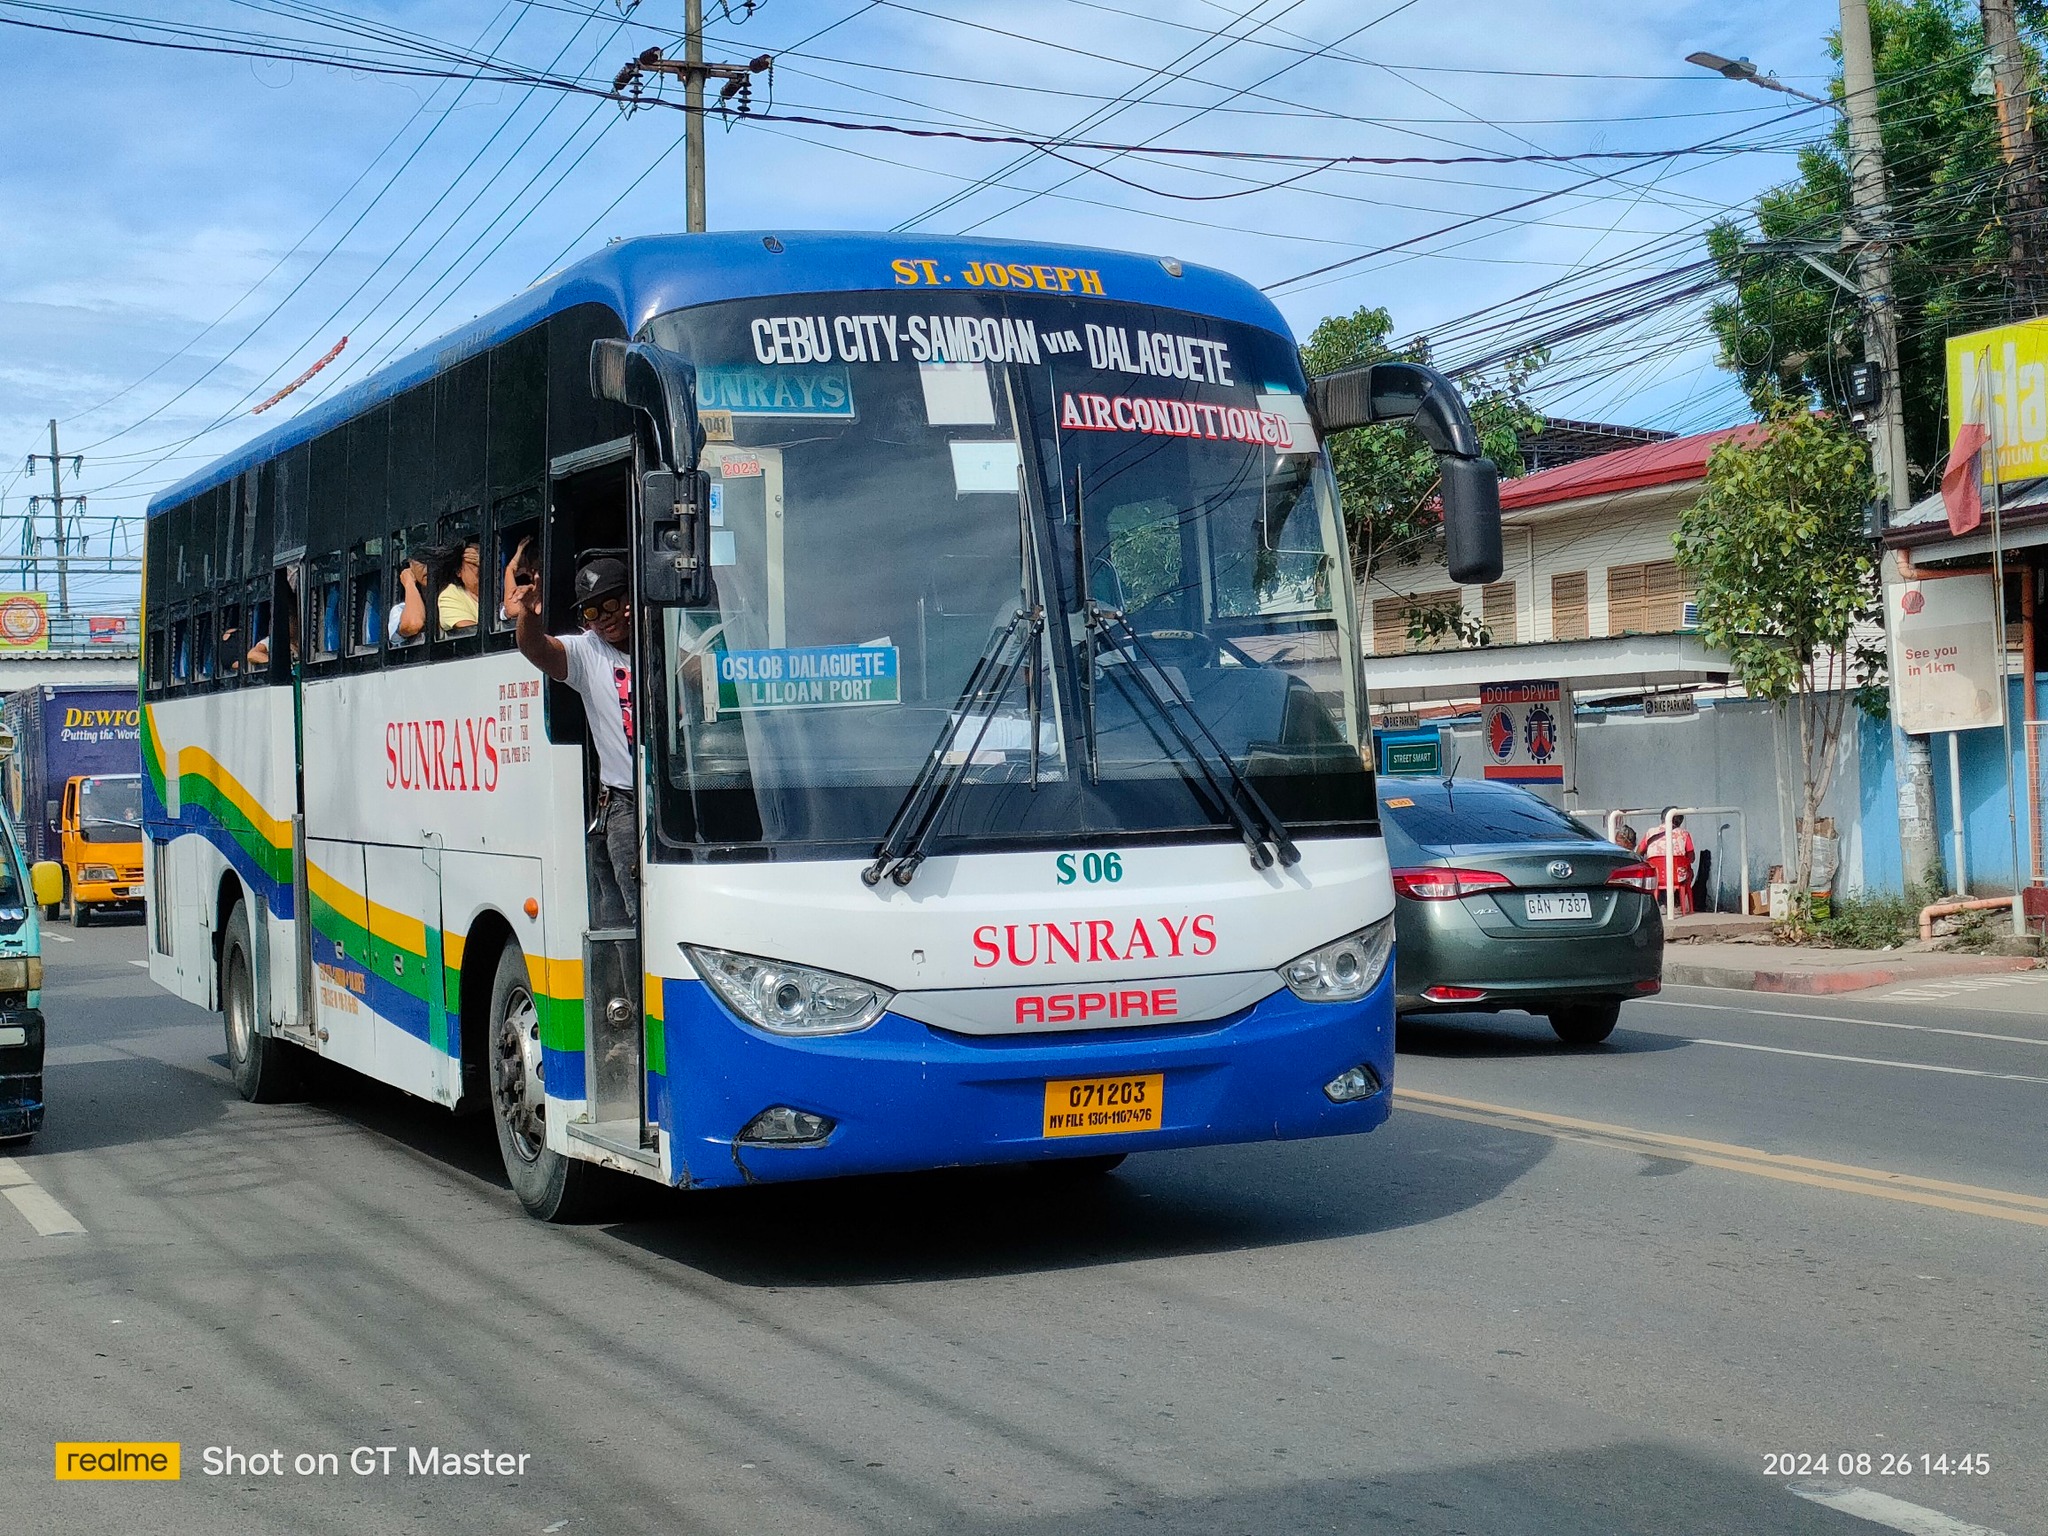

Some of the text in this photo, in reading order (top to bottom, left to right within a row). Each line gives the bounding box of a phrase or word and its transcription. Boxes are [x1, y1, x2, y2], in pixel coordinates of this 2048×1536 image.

[892, 258, 1107, 297] ST. JOSEPH
[750, 314, 1234, 388] CEBU CITY-SAMBOAN VIA DALAGUETE
[698, 373, 846, 408] UNRAYS
[1061, 392, 1294, 449] AIRCONDITIONED
[723, 461, 760, 476] 2023
[1905, 646, 1958, 661] See you
[722, 652, 885, 681] OSLOB DALAGUETE
[1908, 662, 1956, 676] in 1km
[751, 679, 873, 704] LILOAN PORT
[1486, 683, 1556, 703] DOTr DPWH
[64, 708, 140, 727] DEWFO
[1655, 698, 1691, 713] BIKE PARKING
[61, 728, 98, 743] Putting
[100, 728, 114, 740] the
[386, 716, 498, 792] SUNRAYS
[1393, 752, 1431, 764] STREET SMART
[1056, 851, 1123, 885] S 06
[1528, 898, 1588, 914] GAN 7387
[972, 914, 1218, 969] SUNRAYS
[1015, 988, 1178, 1025] ASPIRE
[1069, 1081, 1146, 1108] 071203
[1050, 1115, 1064, 1129] MV
[1066, 1112, 1084, 1128] FILE
